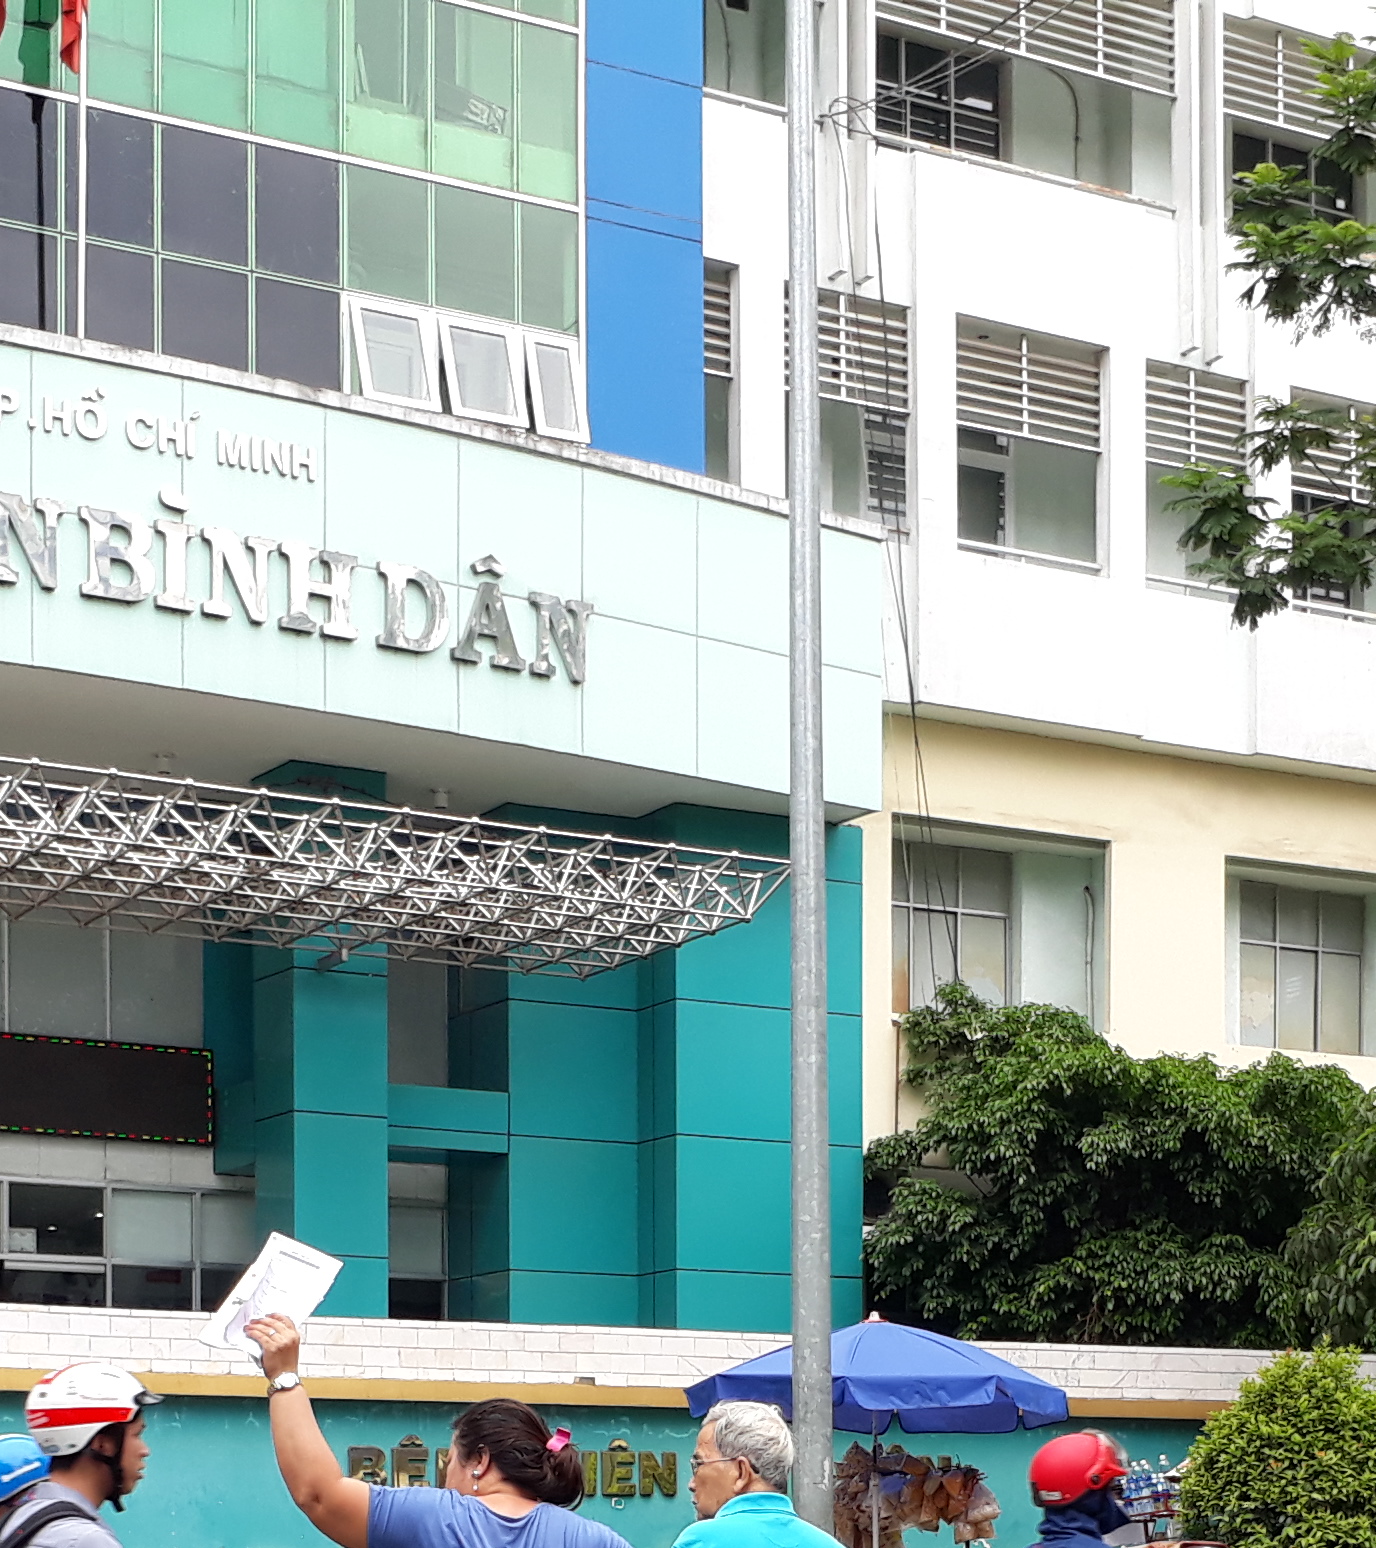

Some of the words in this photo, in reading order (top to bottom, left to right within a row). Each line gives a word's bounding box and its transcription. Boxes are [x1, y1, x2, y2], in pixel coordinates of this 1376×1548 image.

[124, 410, 202, 460] CHÍ
[216, 428, 319, 483] MINH
[77, 487, 361, 642] BÌNH
[375, 554, 596, 686] DÂN
